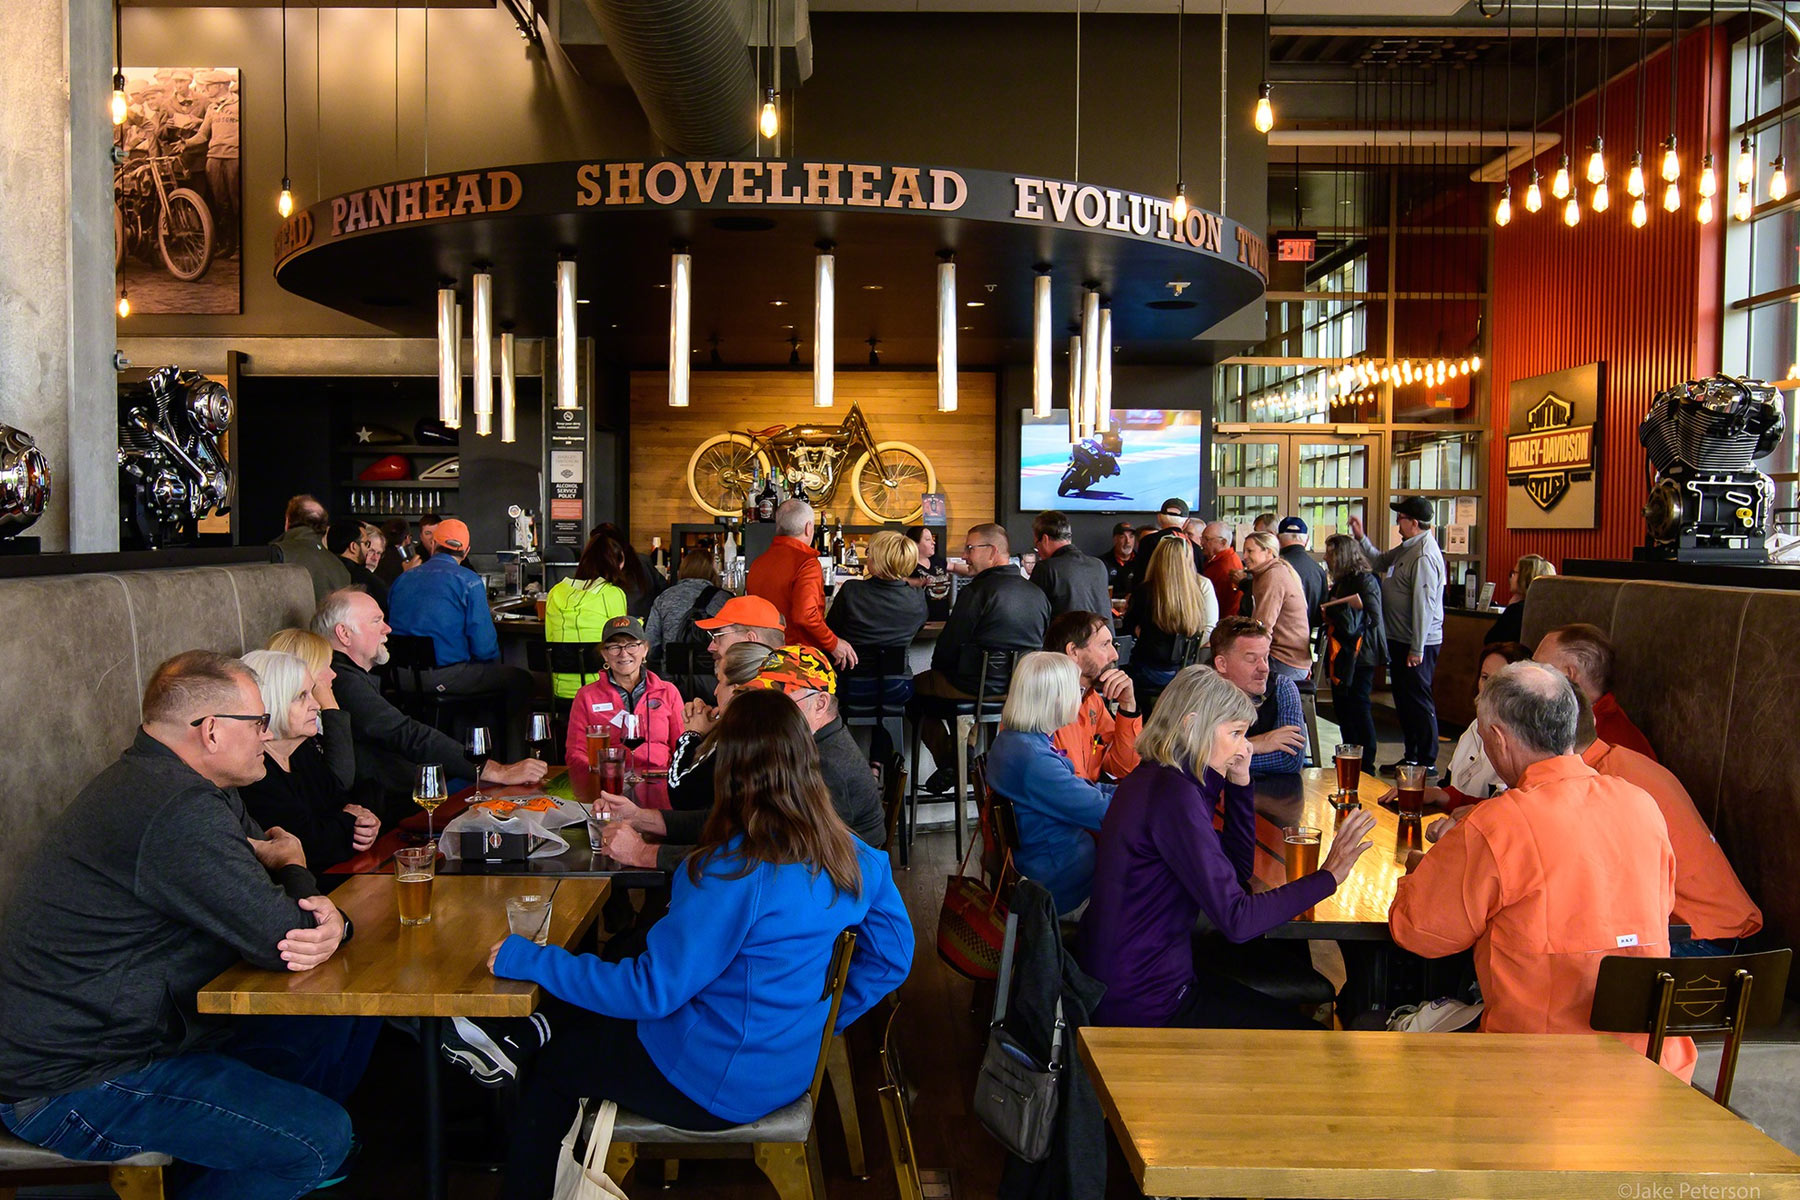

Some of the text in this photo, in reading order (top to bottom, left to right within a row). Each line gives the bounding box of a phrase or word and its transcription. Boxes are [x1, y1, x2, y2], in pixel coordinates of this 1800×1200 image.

[331, 171, 523, 237] PANHEAD
[576, 161, 968, 211] SHOVELHEAD
[1014, 178, 1223, 253] EVOLUTION
[1283, 241, 1311, 259] EXIT
[1508, 432, 1589, 468] HARLEY-DAVIDSON
